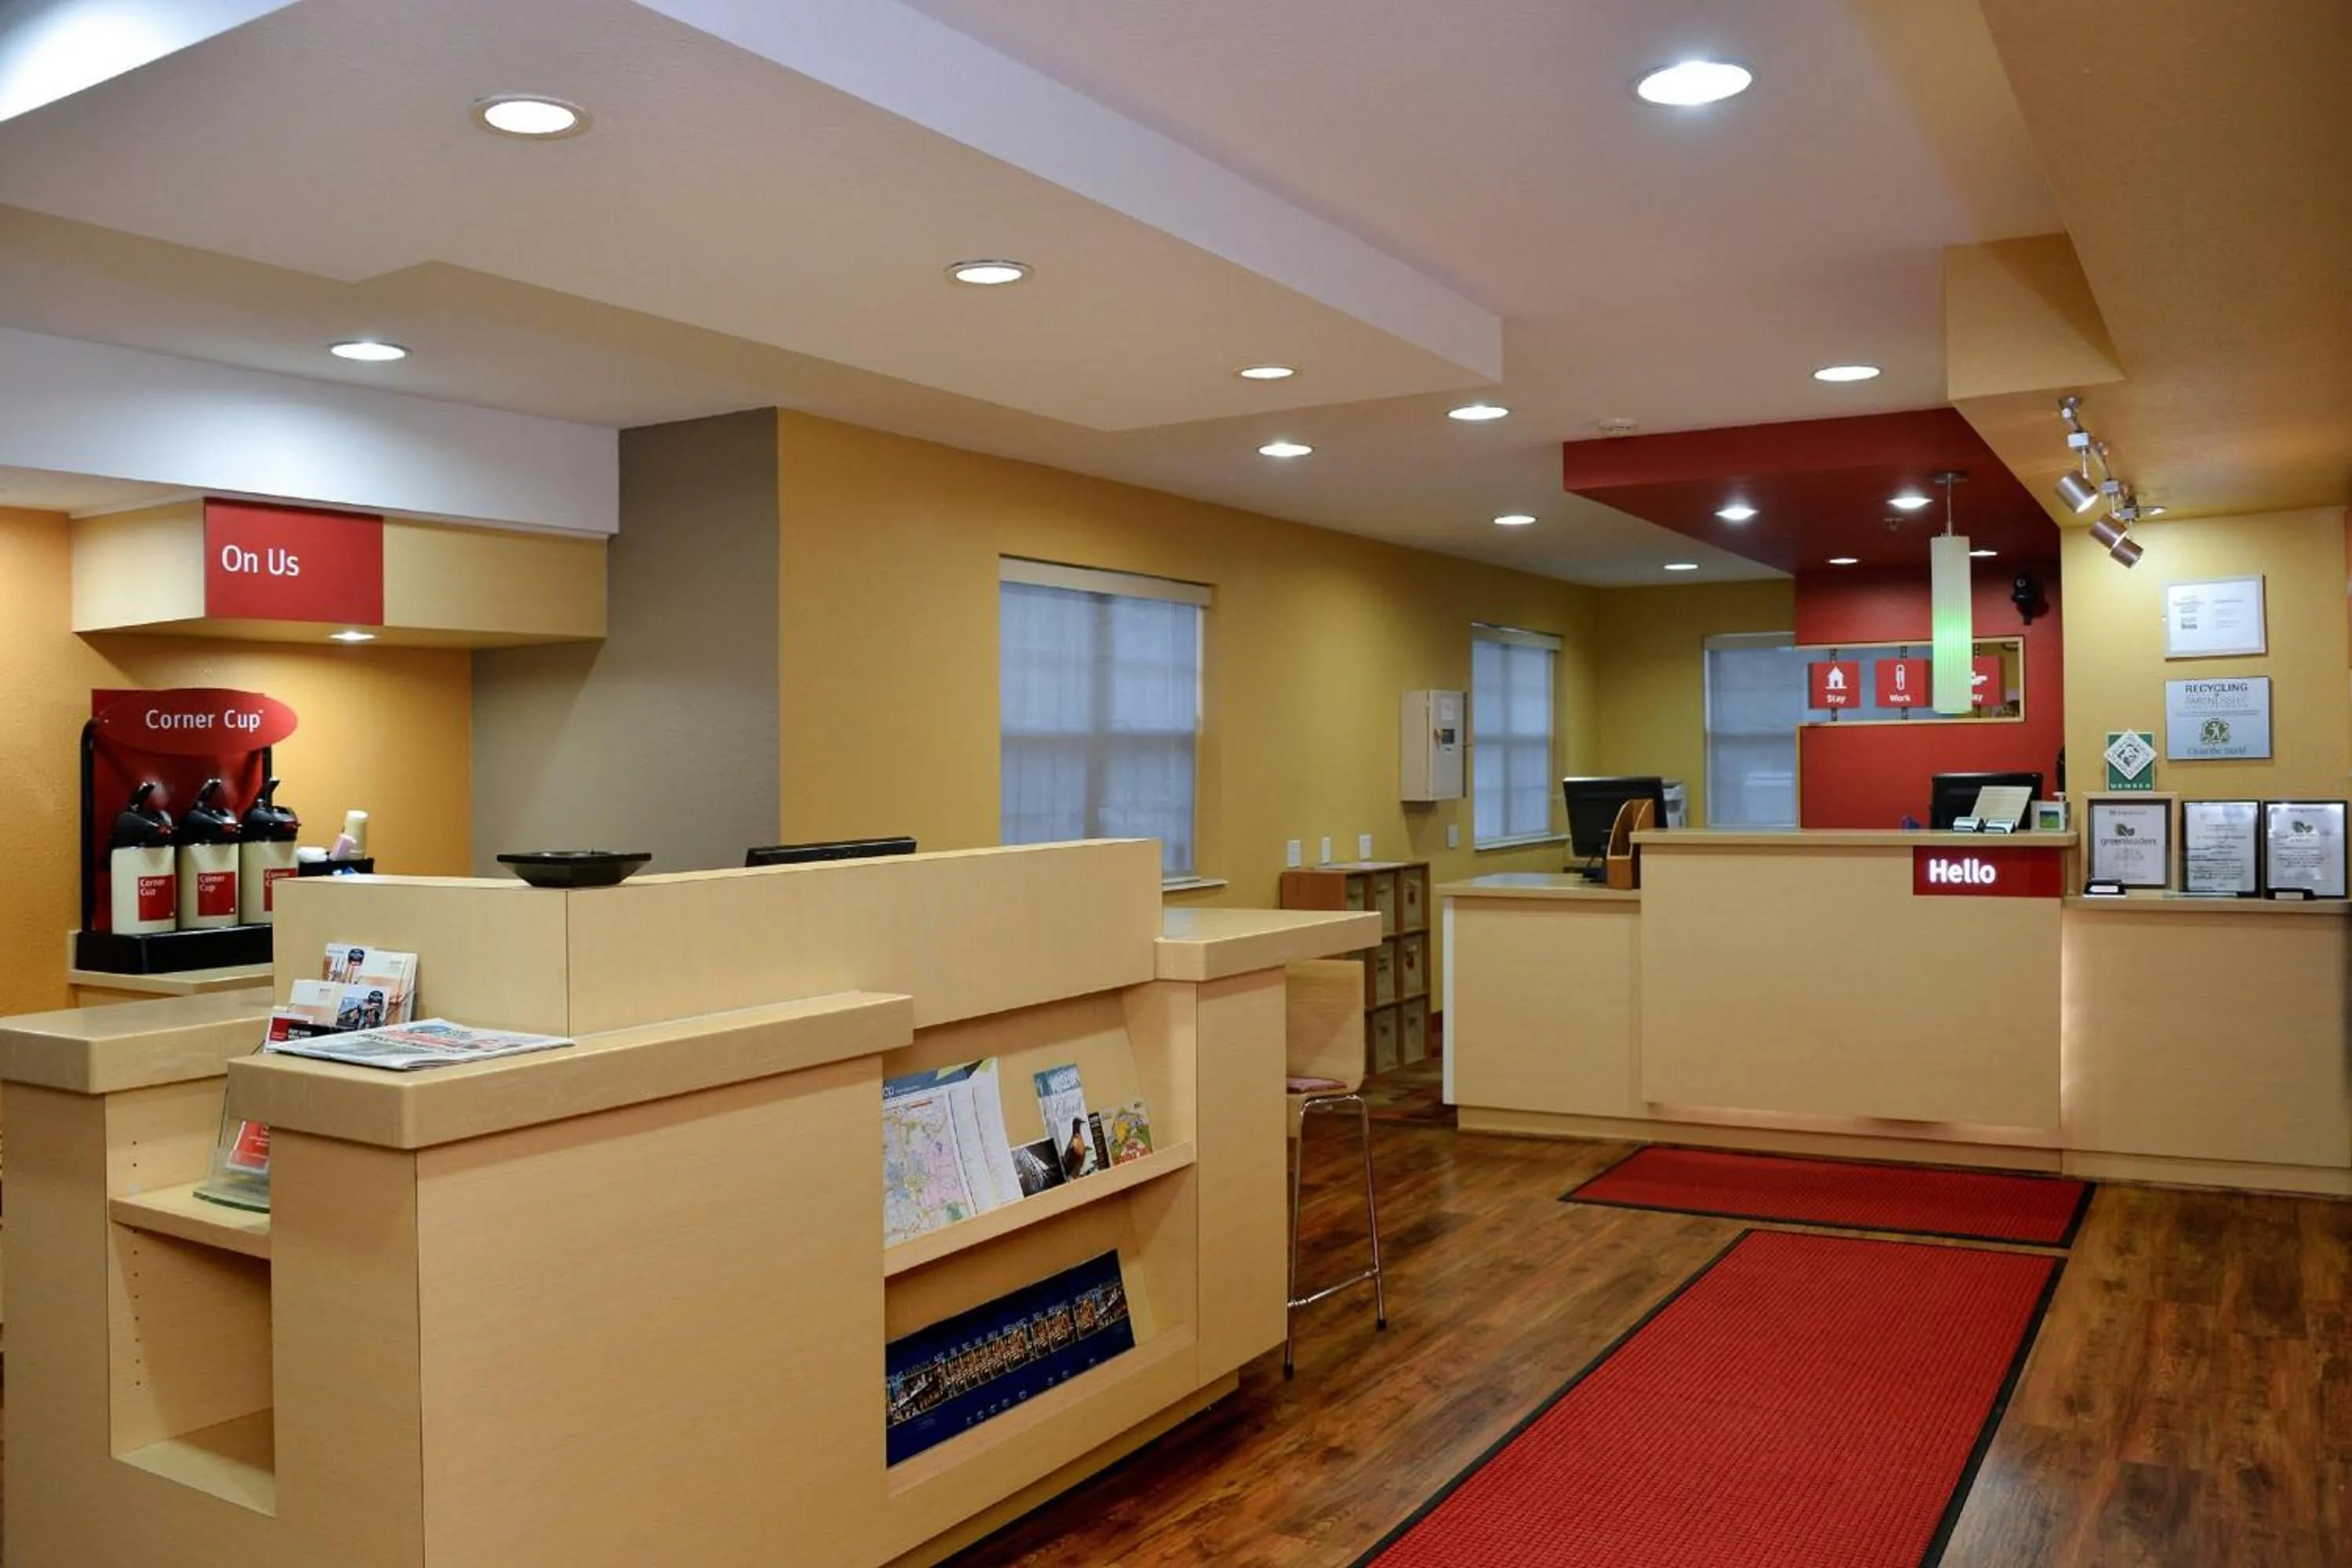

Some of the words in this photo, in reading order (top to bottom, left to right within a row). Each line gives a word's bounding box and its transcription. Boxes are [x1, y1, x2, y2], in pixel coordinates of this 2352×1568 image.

[221, 544, 259, 574] On
[267, 547, 300, 577] Us
[1826, 693, 1846, 705] Stay
[1889, 693, 1911, 703] Work
[146, 709, 216, 730] Corner
[223, 709, 261, 734] Cup
[1929, 858, 1996, 884] Hello
[198, 884, 216, 893] Cup
